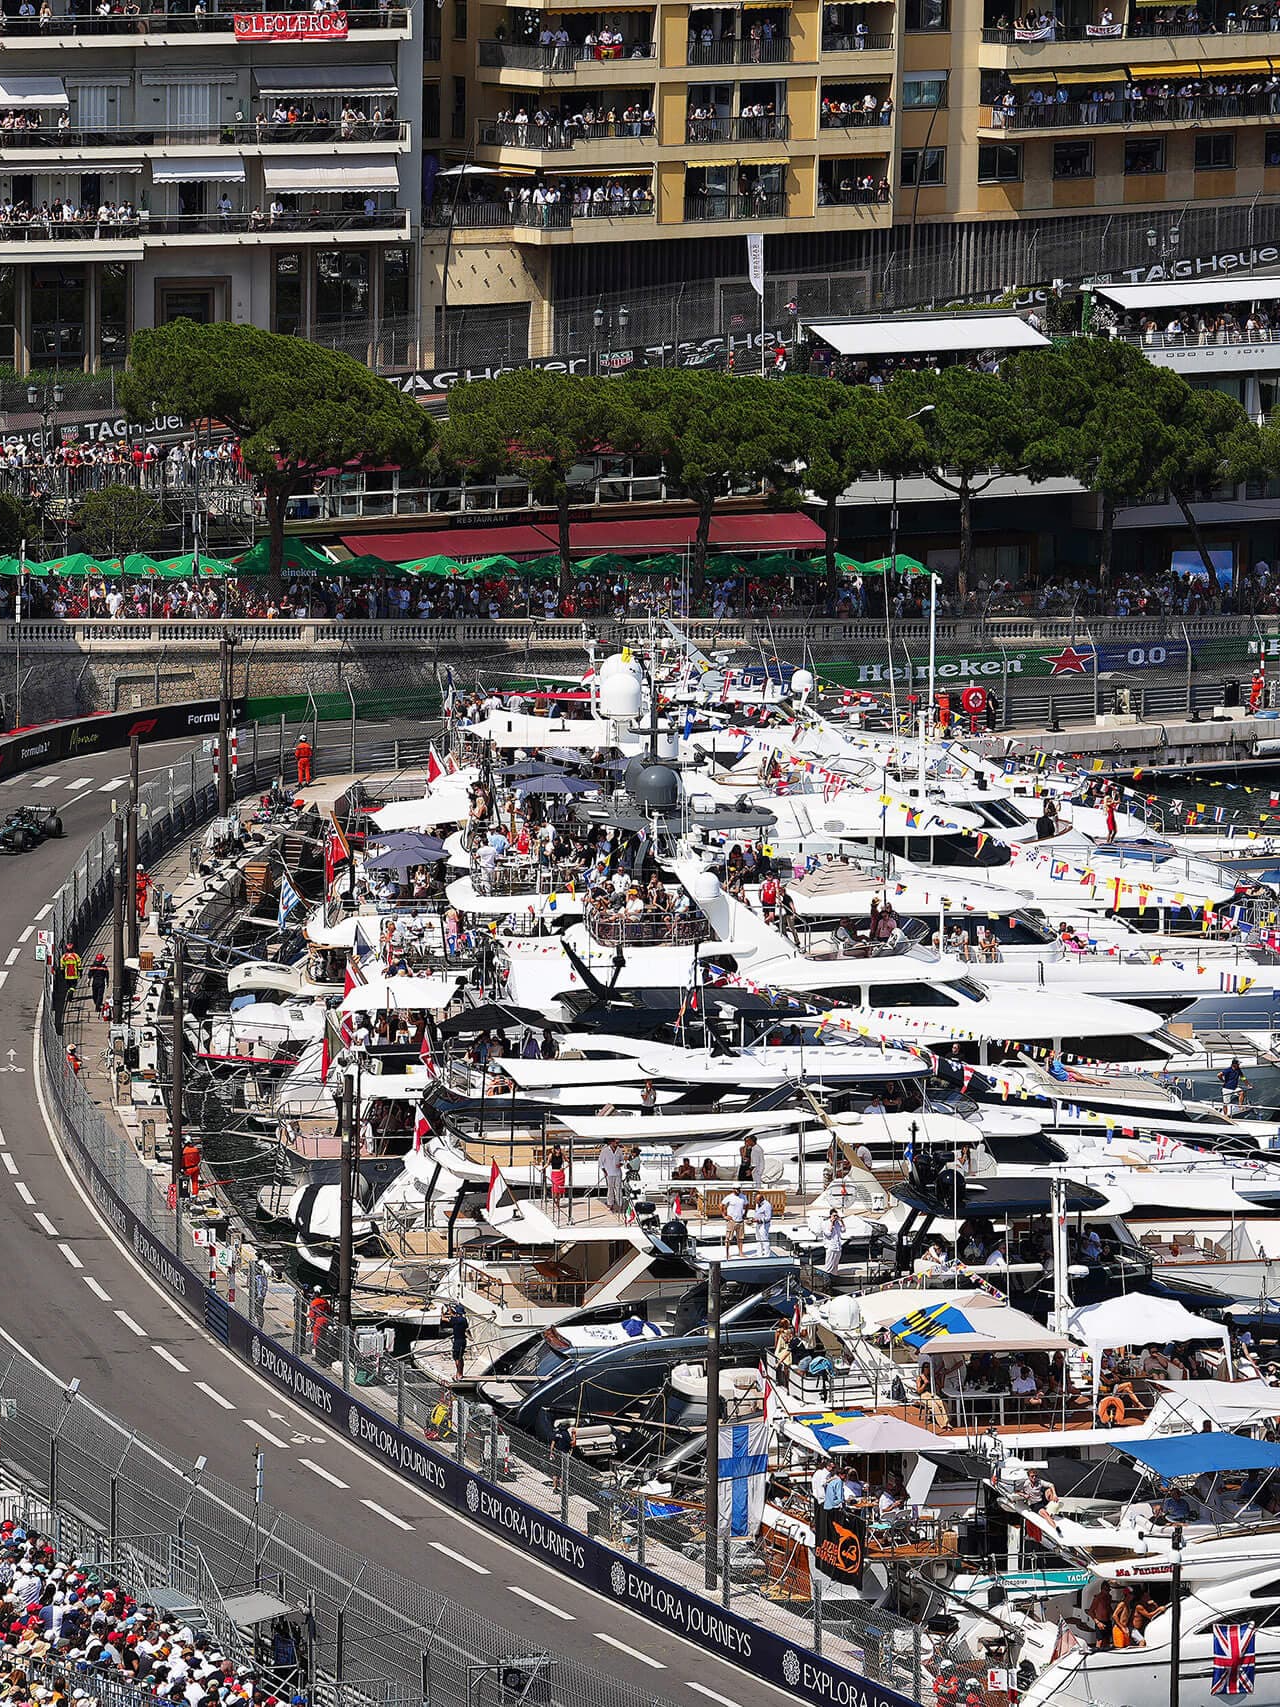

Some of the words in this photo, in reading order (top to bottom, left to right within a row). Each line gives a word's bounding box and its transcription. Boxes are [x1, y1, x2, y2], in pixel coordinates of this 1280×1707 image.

[252, 15, 331, 32] LECLERC
[858, 658, 1024, 682] Heineken
[1127, 646, 1167, 666] 0.0
[140, 1234, 160, 1272] EXPLORA
[261, 1344, 293, 1386] EXPLORA
[293, 1372, 333, 1414] JOURNEYS
[360, 1416, 399, 1461] EXPLORA
[399, 1448, 447, 1490] JOURNEYS
[481, 1491, 528, 1538] EXPLORA
[528, 1519, 585, 1569] JOURNEYS
[628, 1574, 685, 1620] EXPLORA
[685, 1603, 752, 1657] JOURNEYS
